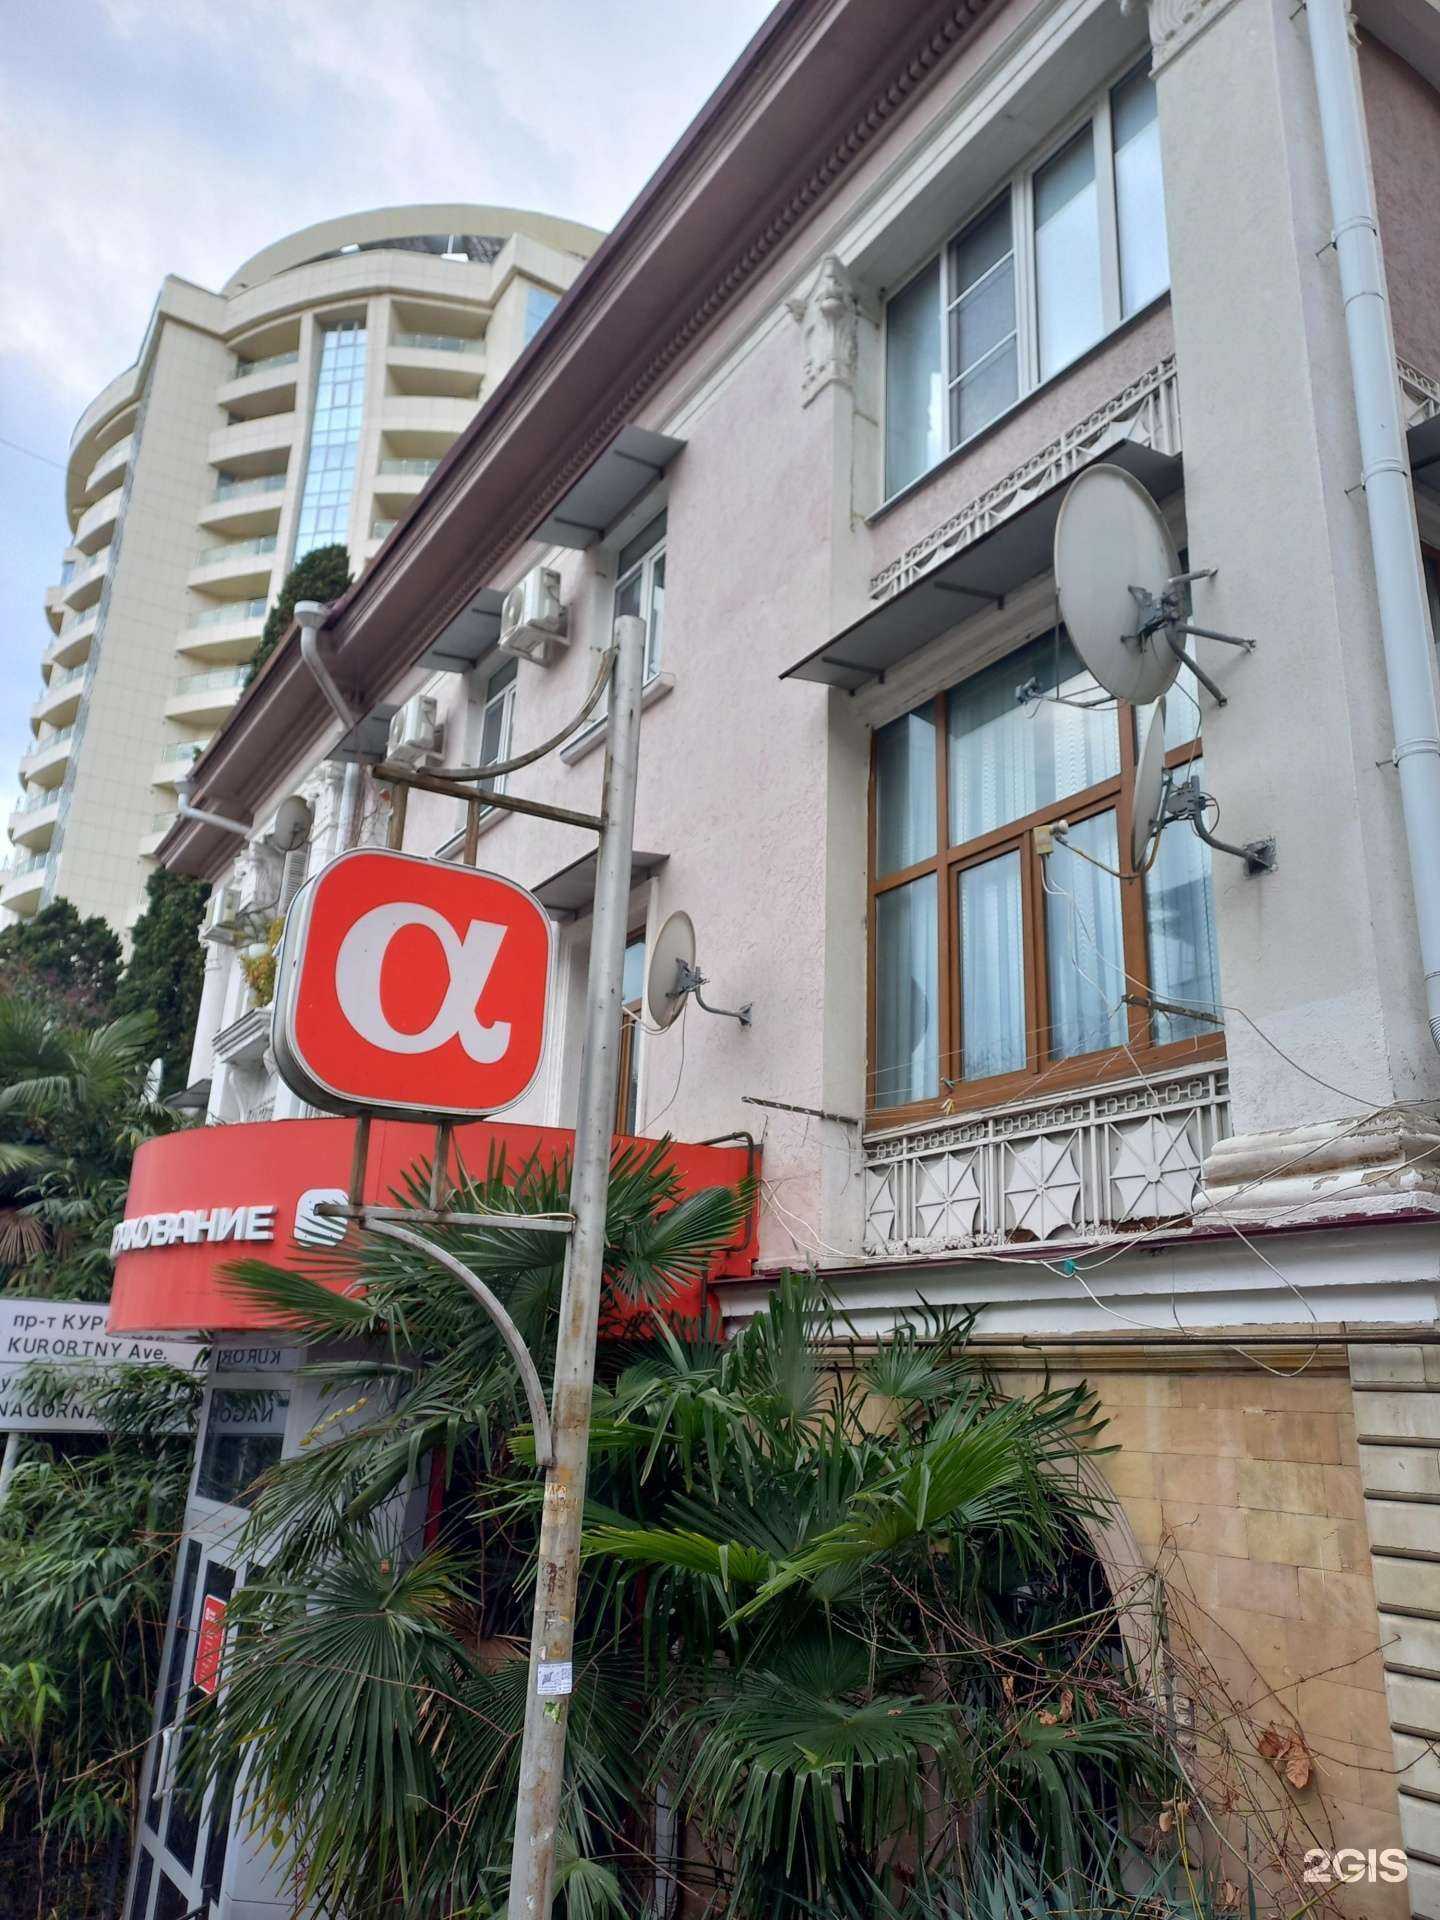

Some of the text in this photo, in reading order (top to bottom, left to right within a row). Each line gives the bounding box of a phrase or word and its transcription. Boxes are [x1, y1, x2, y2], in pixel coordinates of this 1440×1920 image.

[13, 1314, 57, 1331] пр-т
[8, 1337, 167, 1361] KURORTNY Ave.
